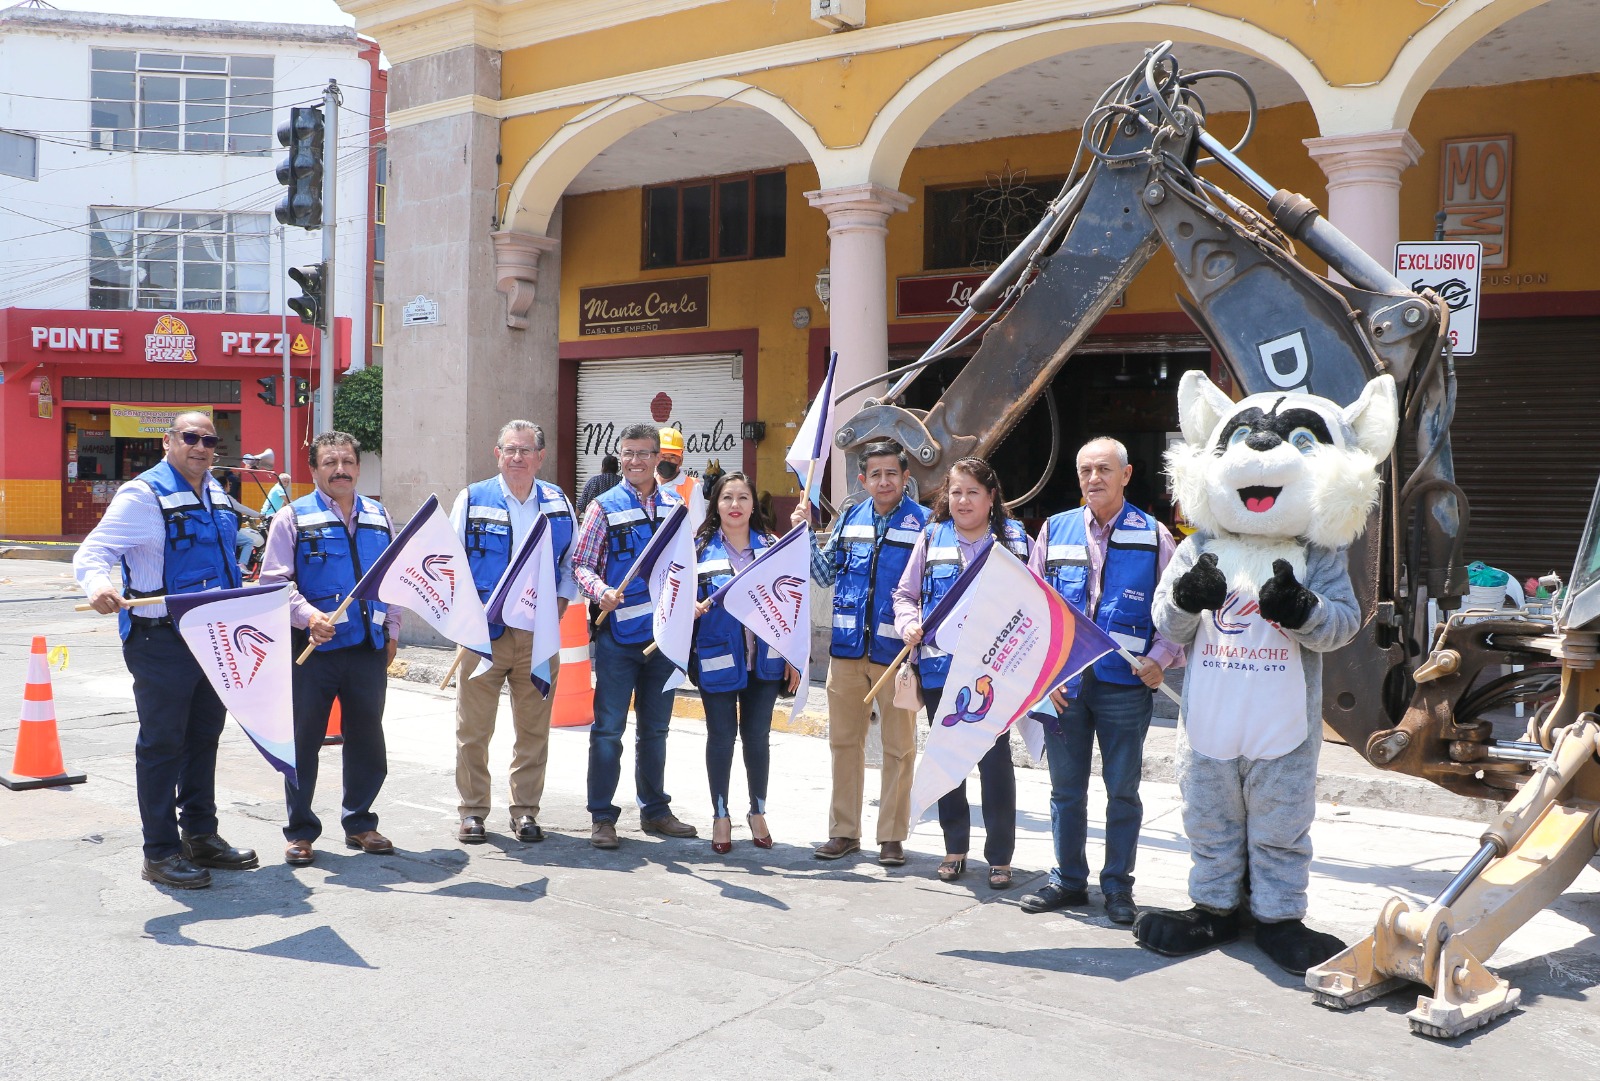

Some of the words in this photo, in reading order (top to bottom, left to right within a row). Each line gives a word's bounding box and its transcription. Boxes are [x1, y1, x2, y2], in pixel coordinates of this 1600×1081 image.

[1446, 142, 1505, 201] MO
[1398, 253, 1475, 271] EXCLUSIVO
[584, 297, 642, 320] Monte
[644, 292, 698, 317] Carlo
[31, 326, 120, 350] PONTE
[585, 327, 607, 335] CASA
[610, 326, 621, 334] DE
[624, 322, 659, 332] EMPEÑO
[146, 334, 193, 349] PONTE
[82, 444, 115, 455] HAMBRE
[399, 575, 430, 606] CORTAZAR,
[747, 590, 770, 625] CORTAZAR,
[206, 622, 224, 671] CORTAZAR,
[982, 608, 1025, 665] Cortazar
[991, 635, 1019, 673] ERES
[1016, 616, 1033, 637] TÚ
[1001, 650, 1020, 676] GOBIERNO
[1202, 643, 1289, 661] JUMAPACHE
[1010, 657, 1023, 673] 2021
[1202, 659, 1259, 672] CORTAZAR,
[1264, 664, 1286, 672] GTO
